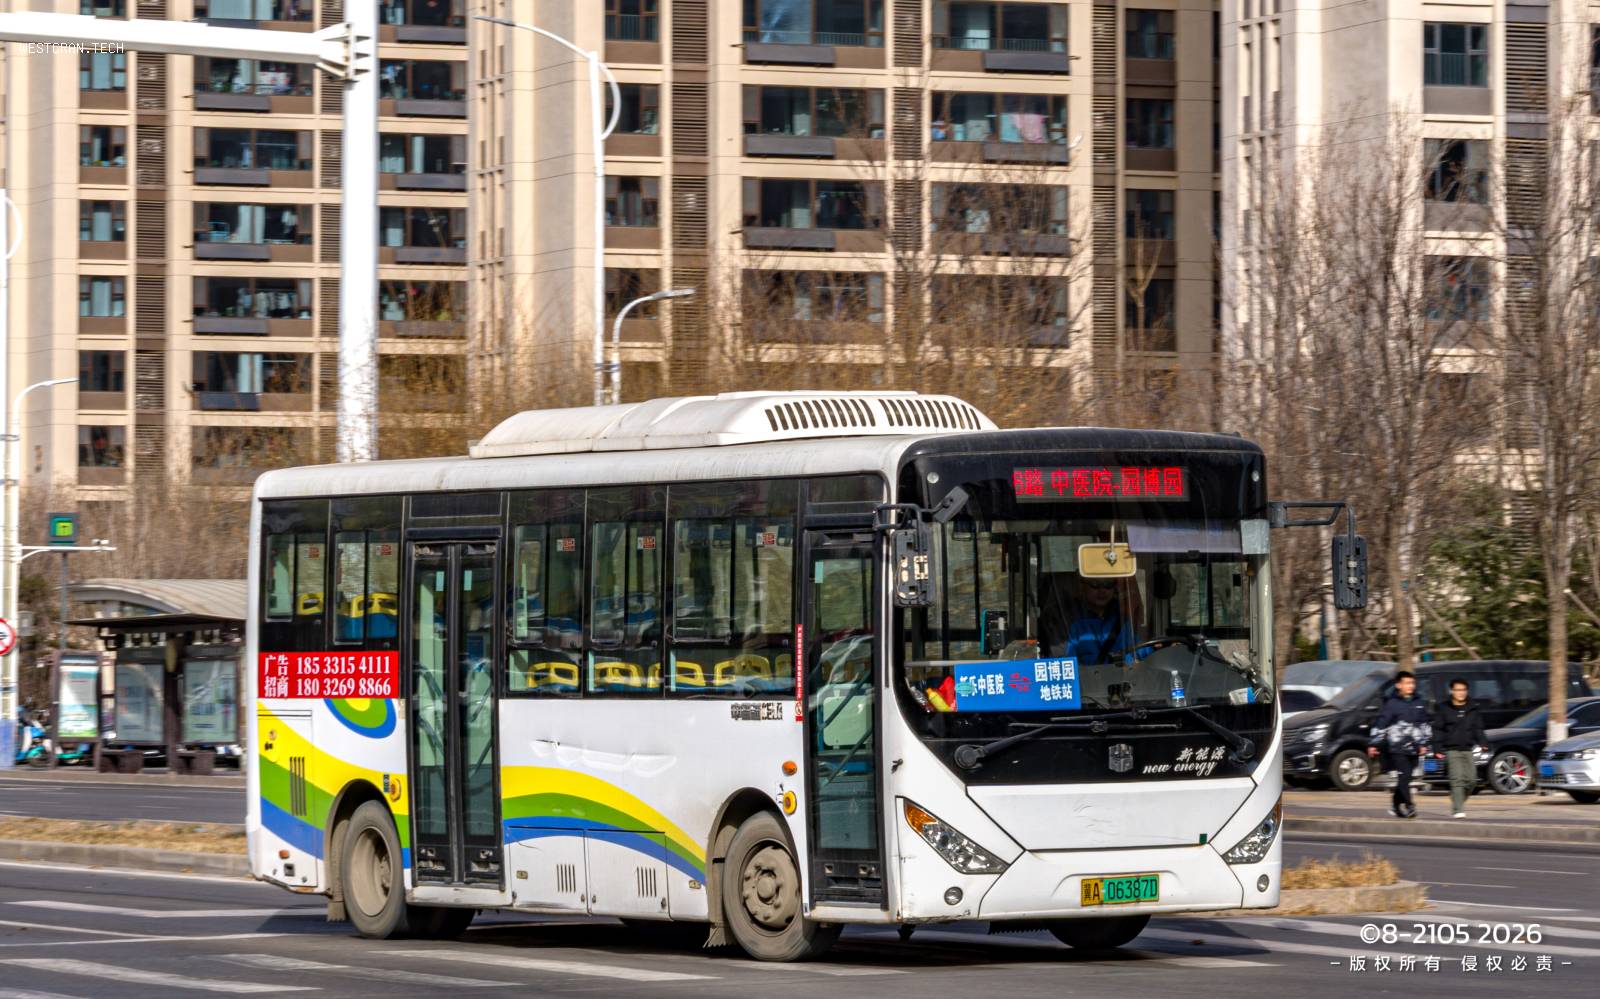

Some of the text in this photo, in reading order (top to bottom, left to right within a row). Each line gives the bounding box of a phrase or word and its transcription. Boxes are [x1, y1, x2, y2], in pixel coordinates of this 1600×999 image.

[1051, 467, 1183, 497] 中医院-园博园
[264, 654, 390, 676] 广告 185 3315 4111
[1034, 660, 1075, 682] 园博园
[264, 676, 391, 697] 招商 180 3269 8866
[1040, 683, 1073, 701] 地铁站
[1176, 745, 1226, 762] 新能源
[1142, 760, 1217, 776] new energy
[1107, 878, 1159, 900] 06387D
